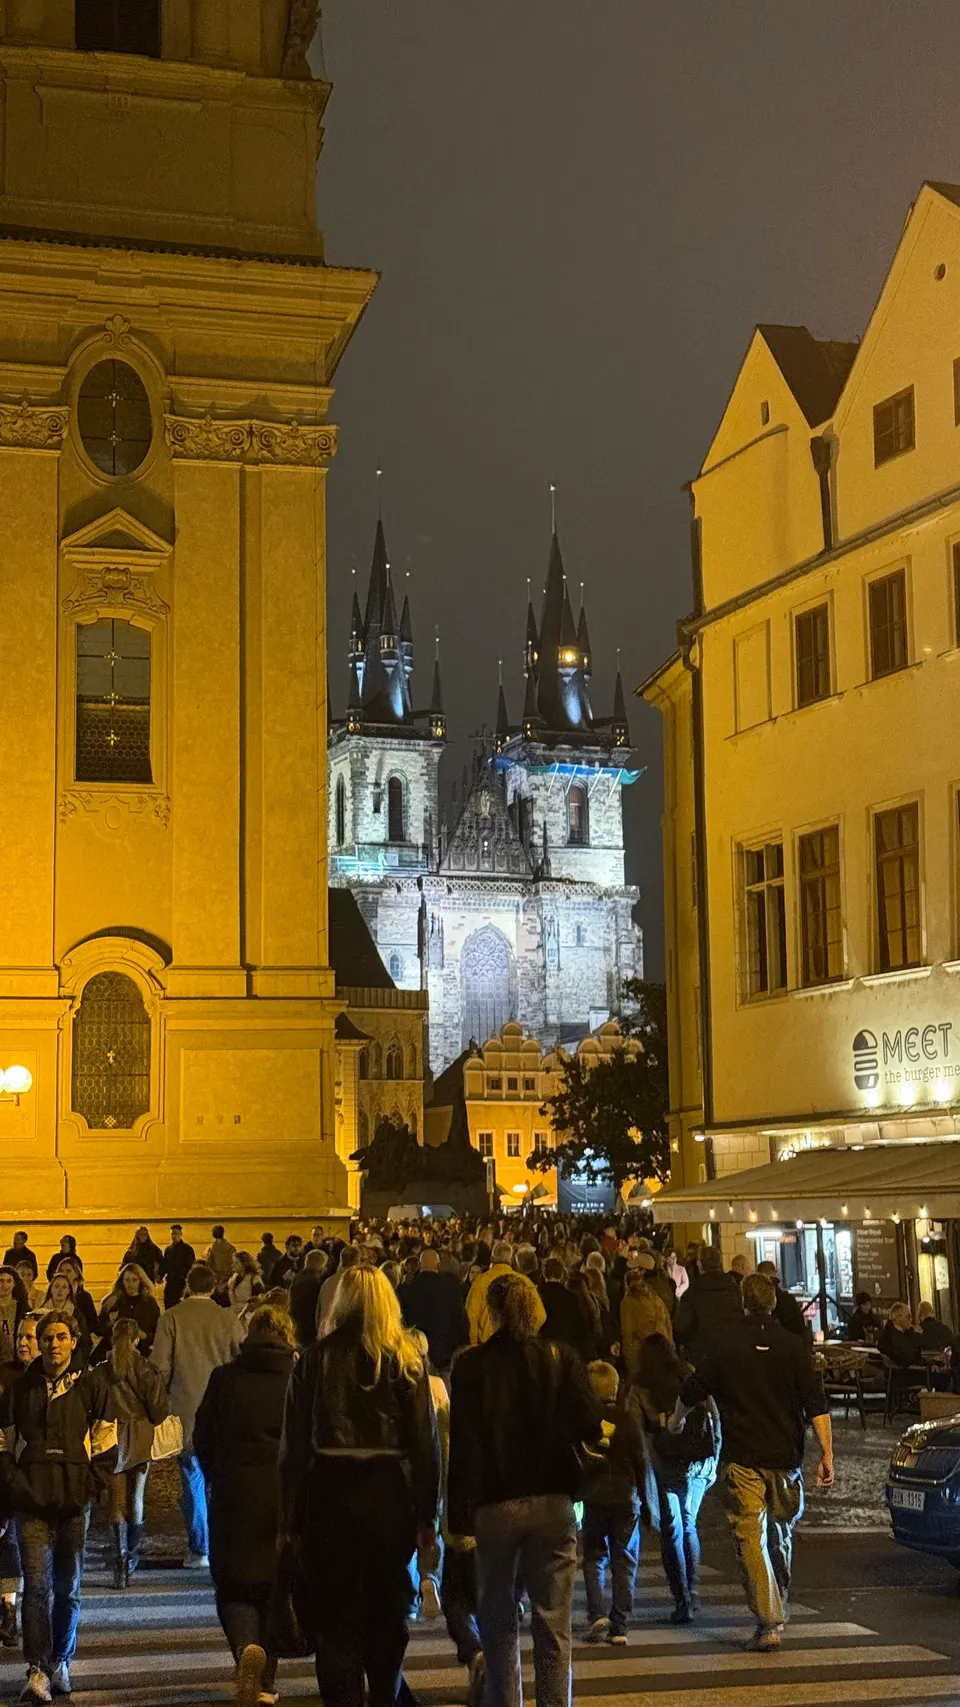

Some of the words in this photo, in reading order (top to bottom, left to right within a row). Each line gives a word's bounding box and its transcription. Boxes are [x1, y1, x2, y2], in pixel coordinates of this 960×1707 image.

[882, 1022, 952, 1065] MEET
[884, 1070, 902, 1084] the
[904, 1067, 941, 1083] burger
